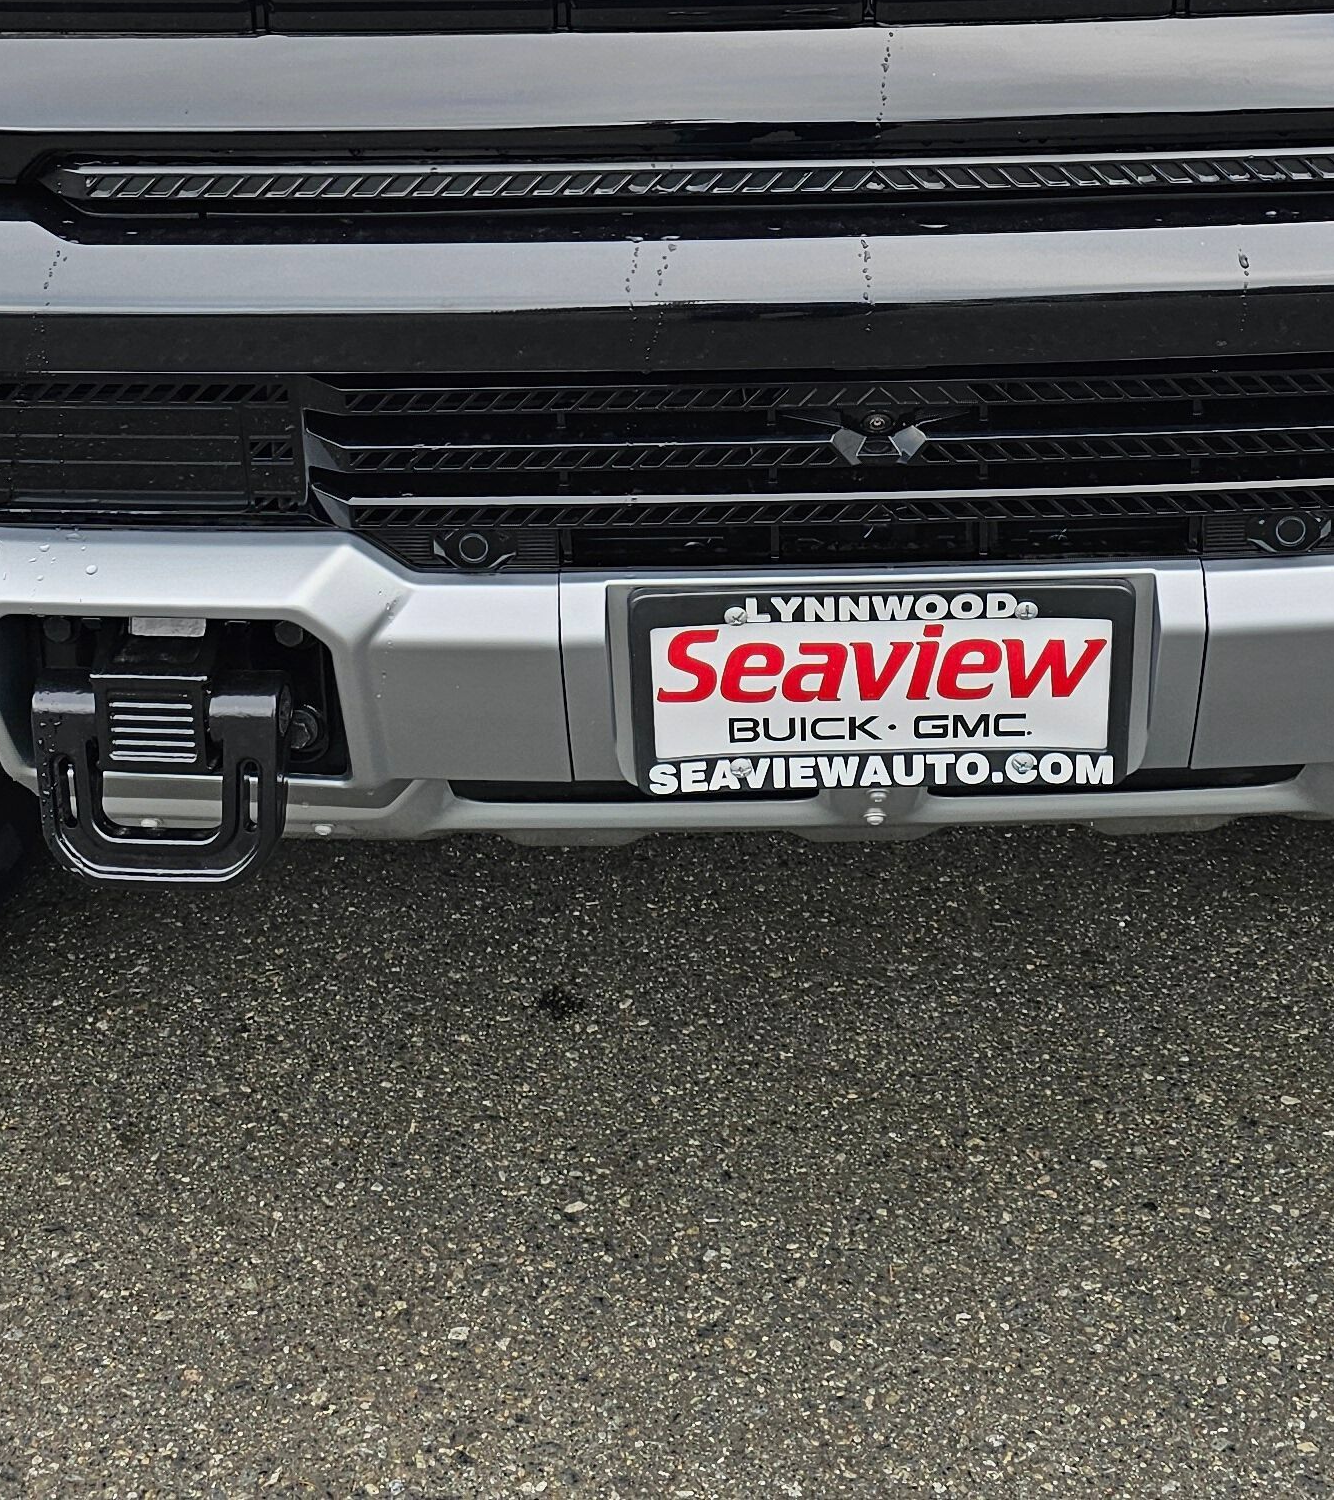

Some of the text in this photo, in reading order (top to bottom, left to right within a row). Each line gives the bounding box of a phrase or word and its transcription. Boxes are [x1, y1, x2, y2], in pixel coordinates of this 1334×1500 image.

[746, 593, 1017, 622] LYNNWOOD
[657, 623, 1108, 703] Seaview
[728, 713, 1028, 744] BUICK GMC
[648, 752, 1115, 796] SEAVIEWAUTO.COM
